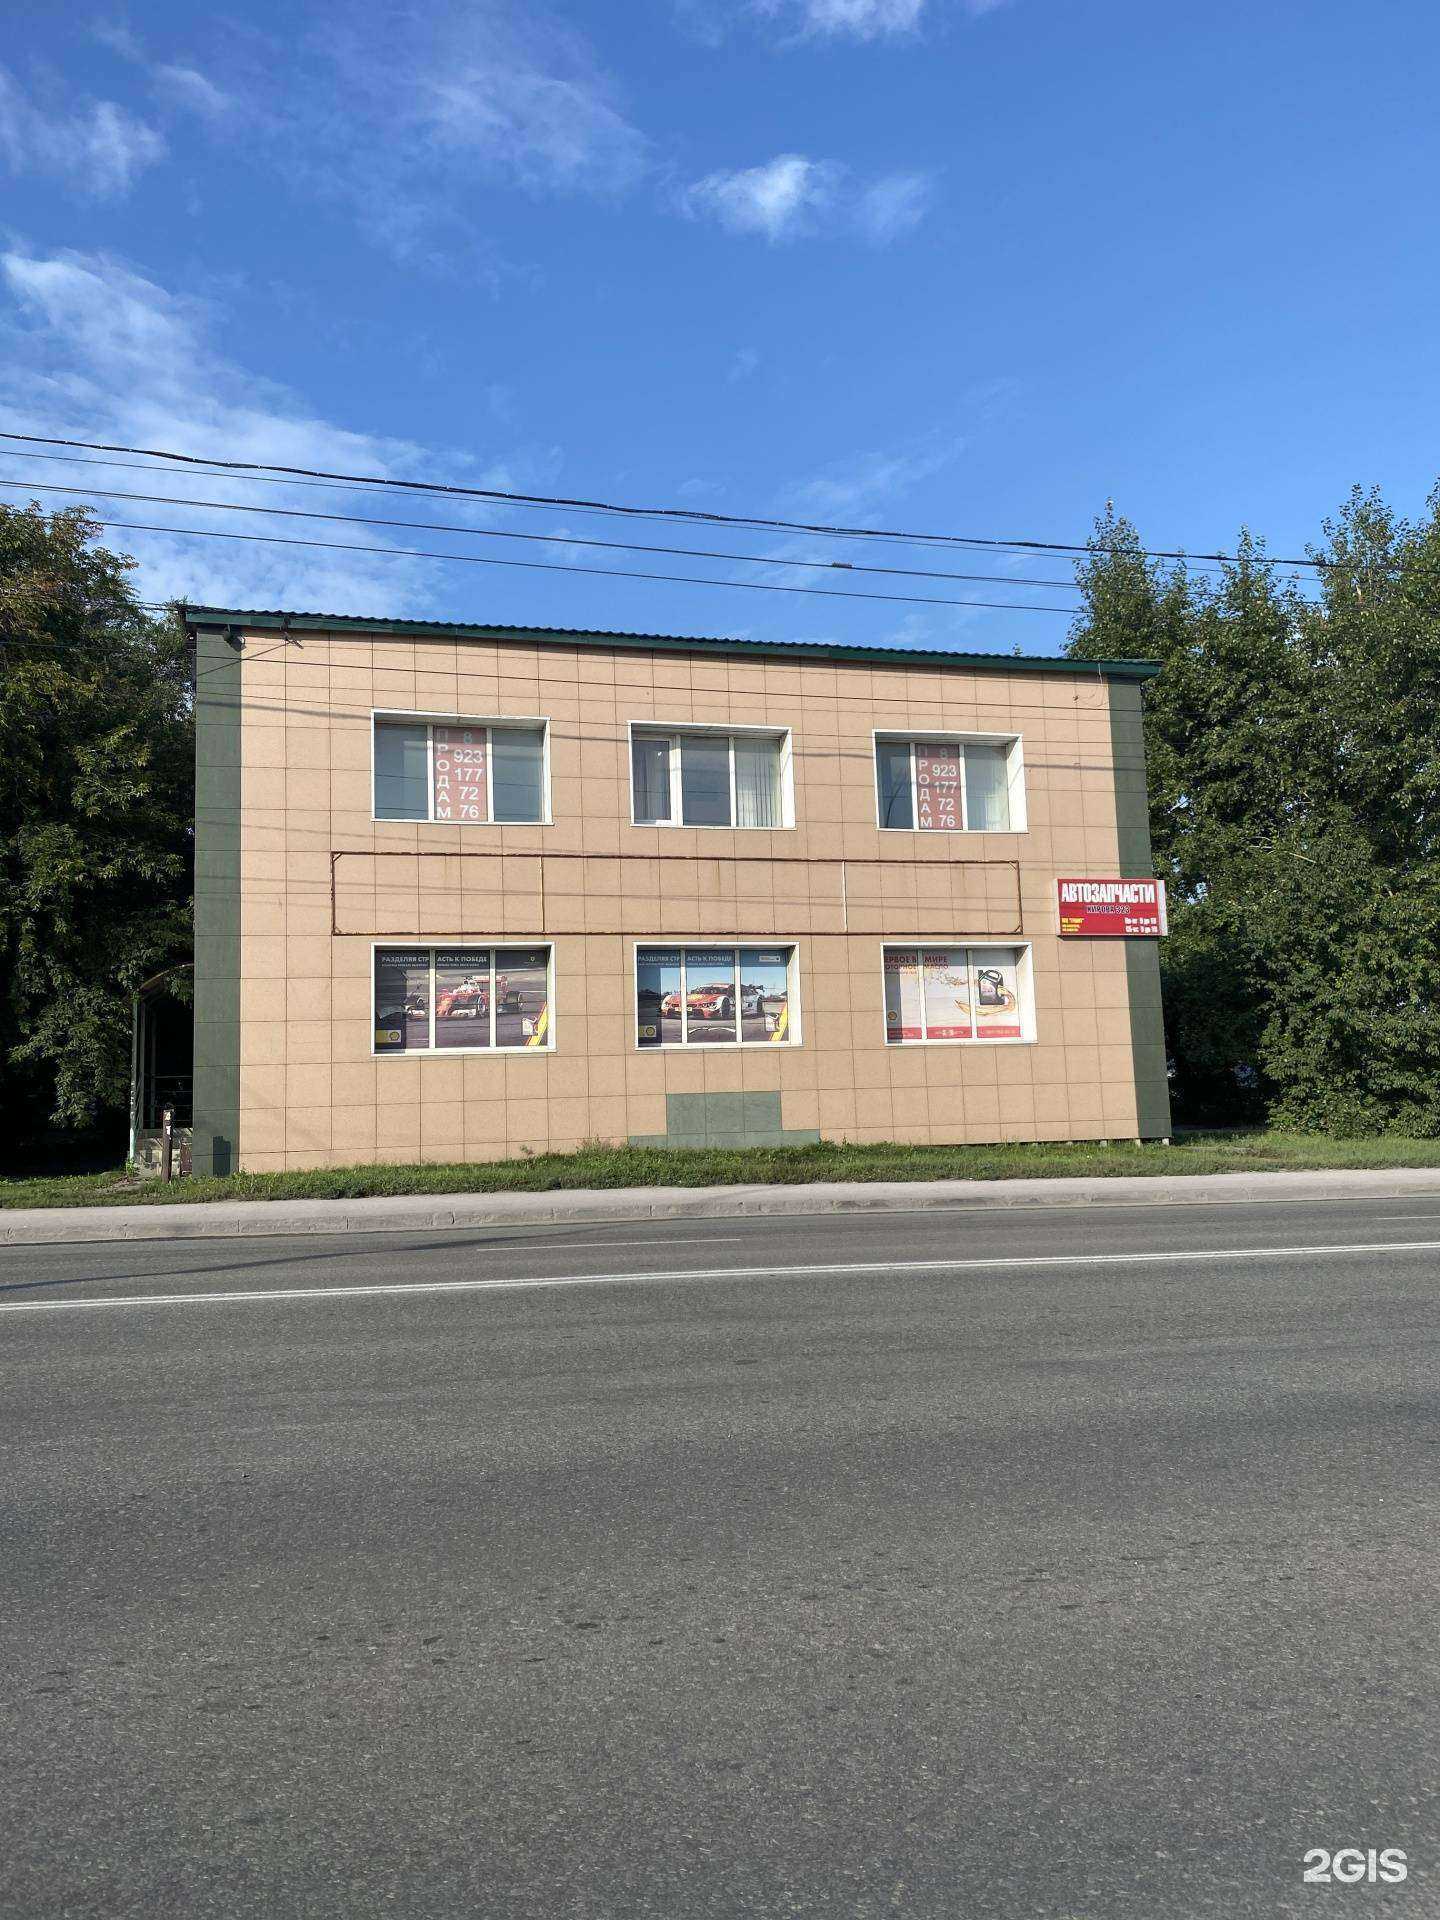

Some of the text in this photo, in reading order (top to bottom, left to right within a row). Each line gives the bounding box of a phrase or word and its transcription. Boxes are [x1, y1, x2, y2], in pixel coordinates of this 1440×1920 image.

[453, 749, 483, 763] 923
[436, 728, 451, 818] ПРОДАМ
[454, 768, 483, 782] 177
[932, 764, 957, 777] 923
[459, 786, 479, 800] 72
[934, 781, 957, 794] 177
[938, 798, 954, 811] 72
[459, 805, 480, 818] 76
[938, 815, 956, 827] 76
[1061, 882, 1155, 903] АВТОЗАПЧАСТИ
[884, 955, 911, 963] ЕРВОЕ
